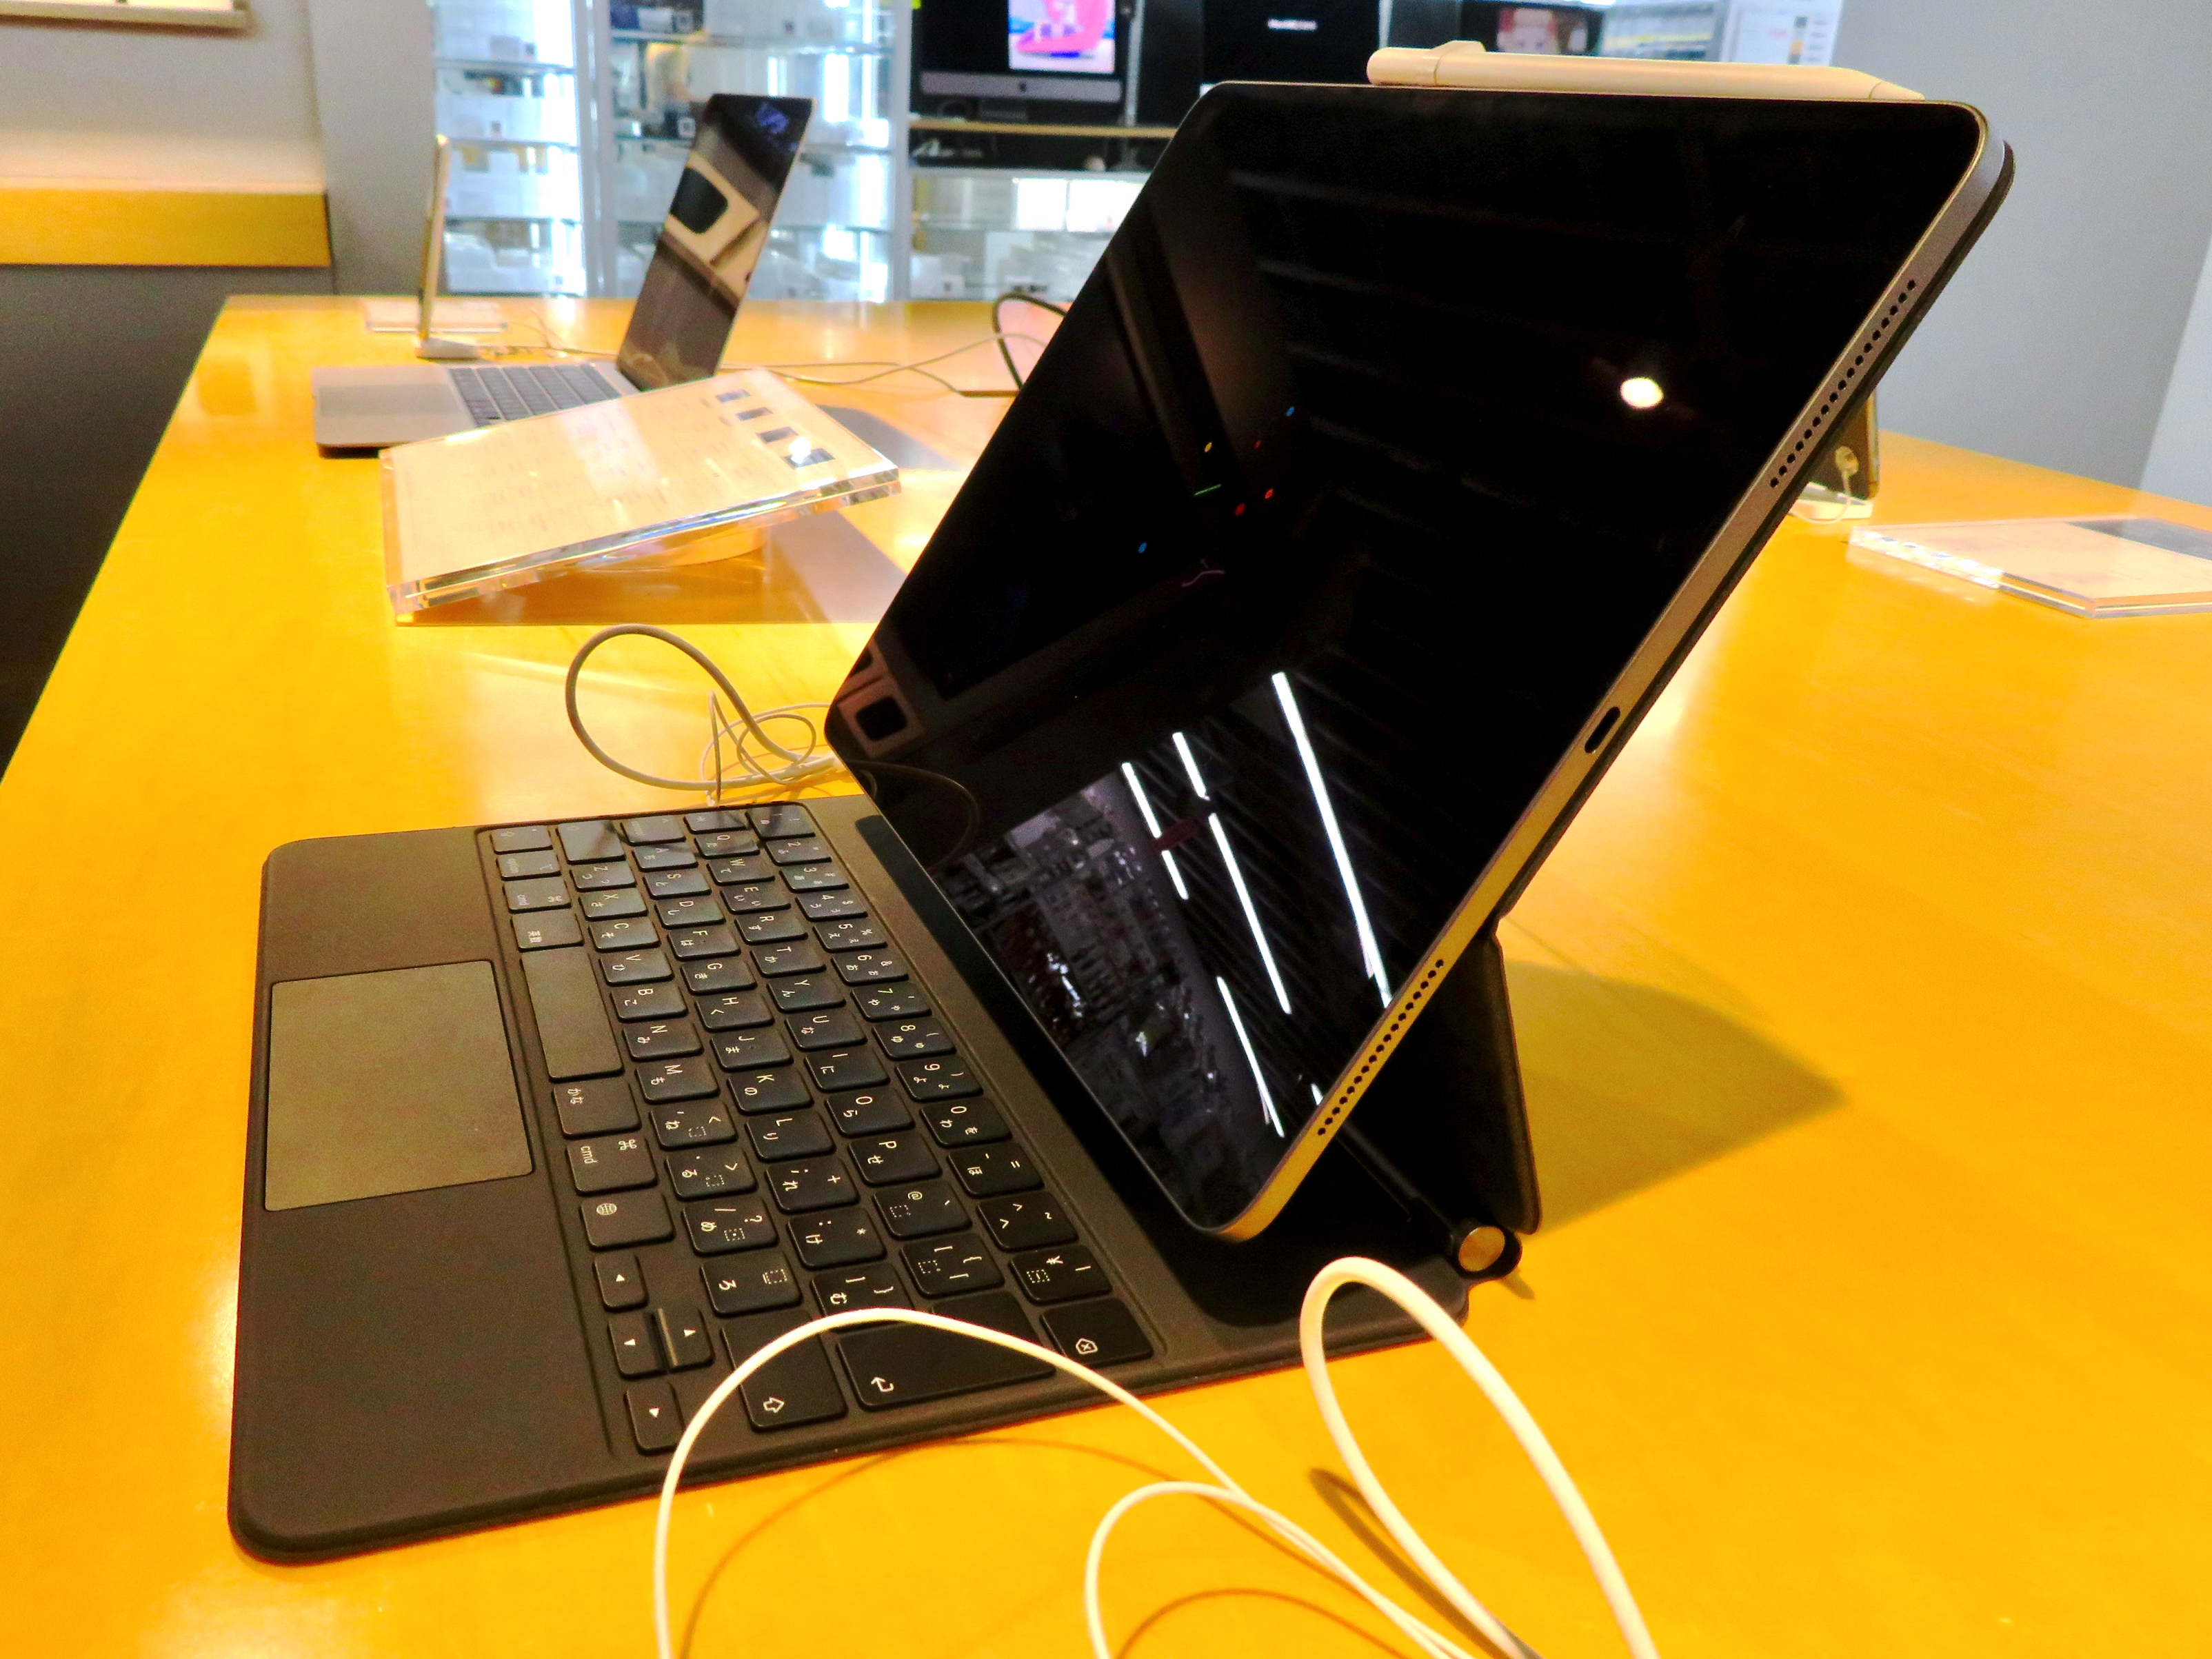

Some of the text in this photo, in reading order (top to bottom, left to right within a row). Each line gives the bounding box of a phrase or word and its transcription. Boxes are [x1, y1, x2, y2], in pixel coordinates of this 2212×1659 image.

[730, 858, 745, 867] W
[517, 894, 530, 905] cmd
[528, 930, 543, 943] 英数
[723, 996, 738, 1005] H
[801, 1027, 814, 1035] な
[636, 1036, 650, 1045] み
[725, 1045, 739, 1054] ま
[665, 1065, 683, 1074] M
[821, 1066, 834, 1074] に
[650, 1076, 665, 1085] も
[756, 1074, 773, 1083] K
[744, 1087, 758, 1095] の
[567, 1088, 583, 1104] かな
[665, 1120, 680, 1130] ね
[776, 1118, 792, 1126] L
[940, 1119, 952, 1128] わ
[965, 1126, 978, 1135] を
[878, 1140, 896, 1149] P
[581, 1146, 597, 1164] cmd
[867, 1155, 883, 1165] せ
[725, 1162, 738, 1171] >
[682, 1169, 697, 1178] る
[967, 1167, 983, 1176] ほ
[827, 1175, 841, 1183] +
[782, 1180, 798, 1192] れ
[907, 1191, 923, 1200] @
[701, 1221, 716, 1232] め
[805, 1234, 823, 1245] け
[1046, 1256, 1063, 1265] ¥
[718, 1280, 736, 1291] ろ
[830, 1292, 847, 1305] む
